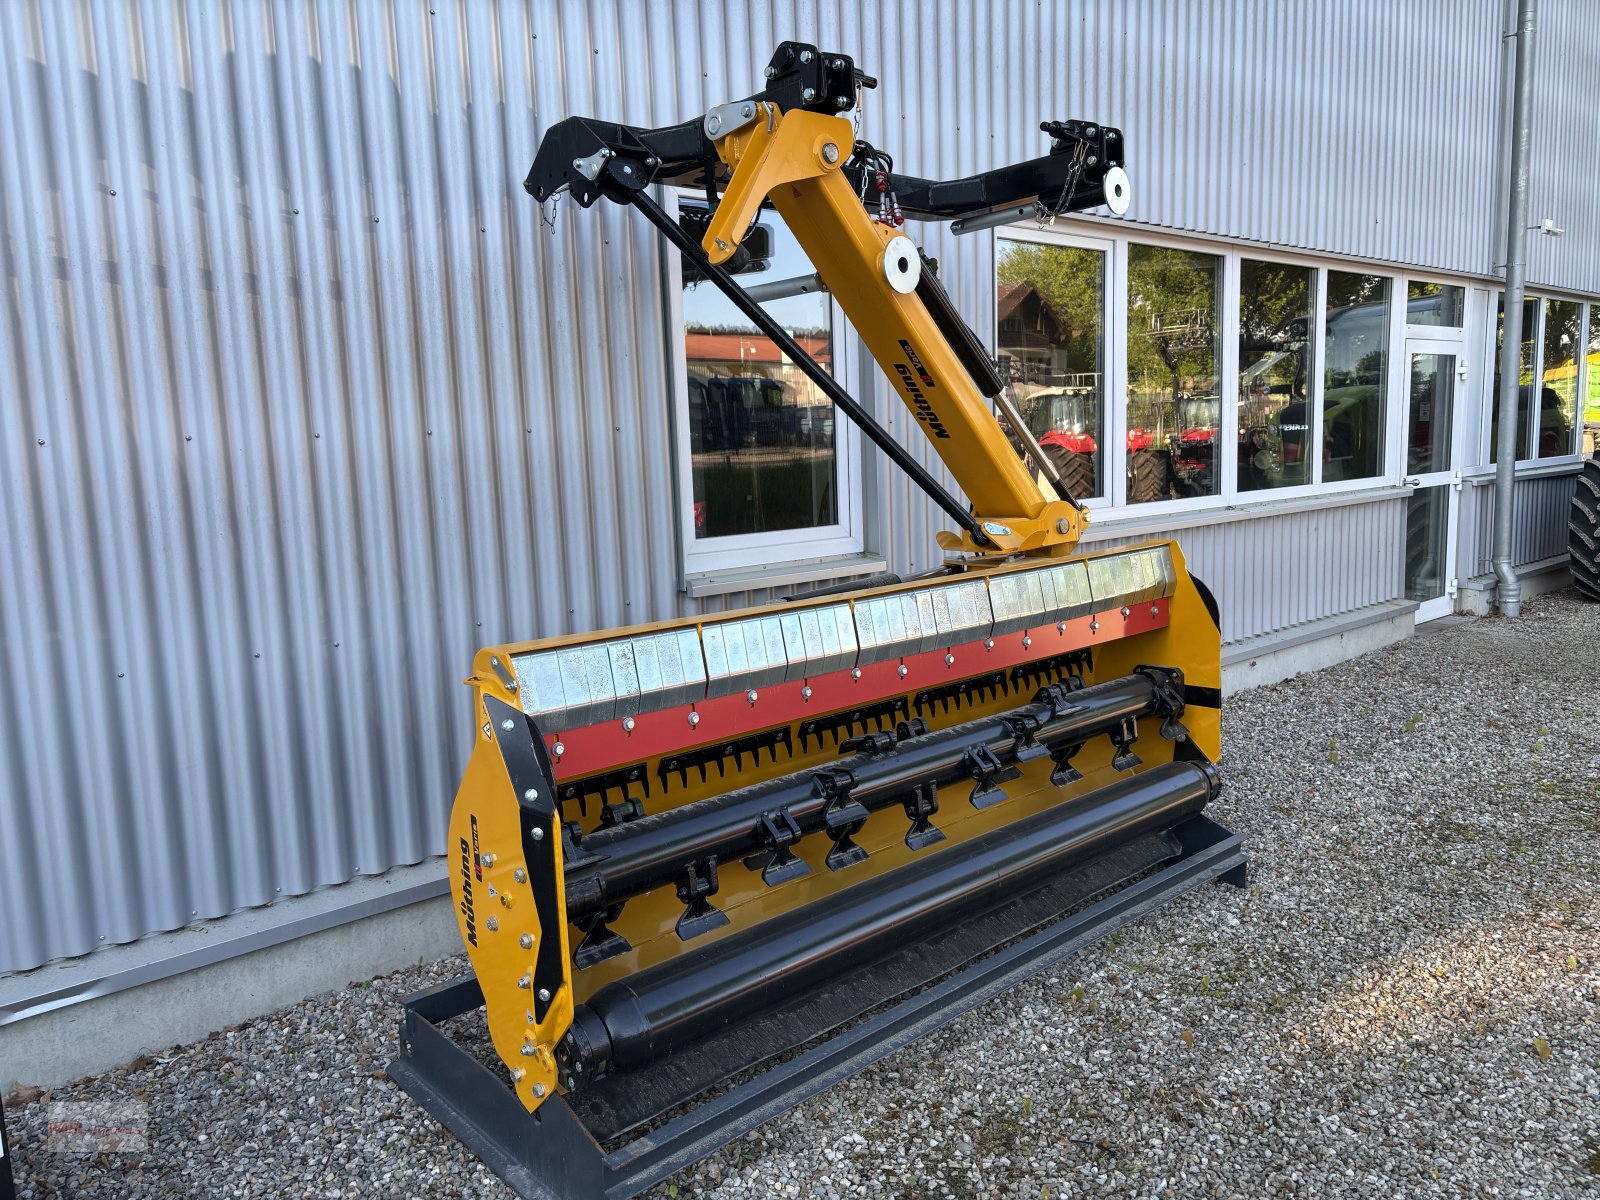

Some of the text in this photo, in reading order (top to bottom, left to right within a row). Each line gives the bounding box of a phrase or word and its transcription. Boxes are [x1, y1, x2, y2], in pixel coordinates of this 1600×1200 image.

[904, 345, 922, 369] Vario
[893, 363, 951, 438] Müthing
[460, 836, 478, 948] Müthing
